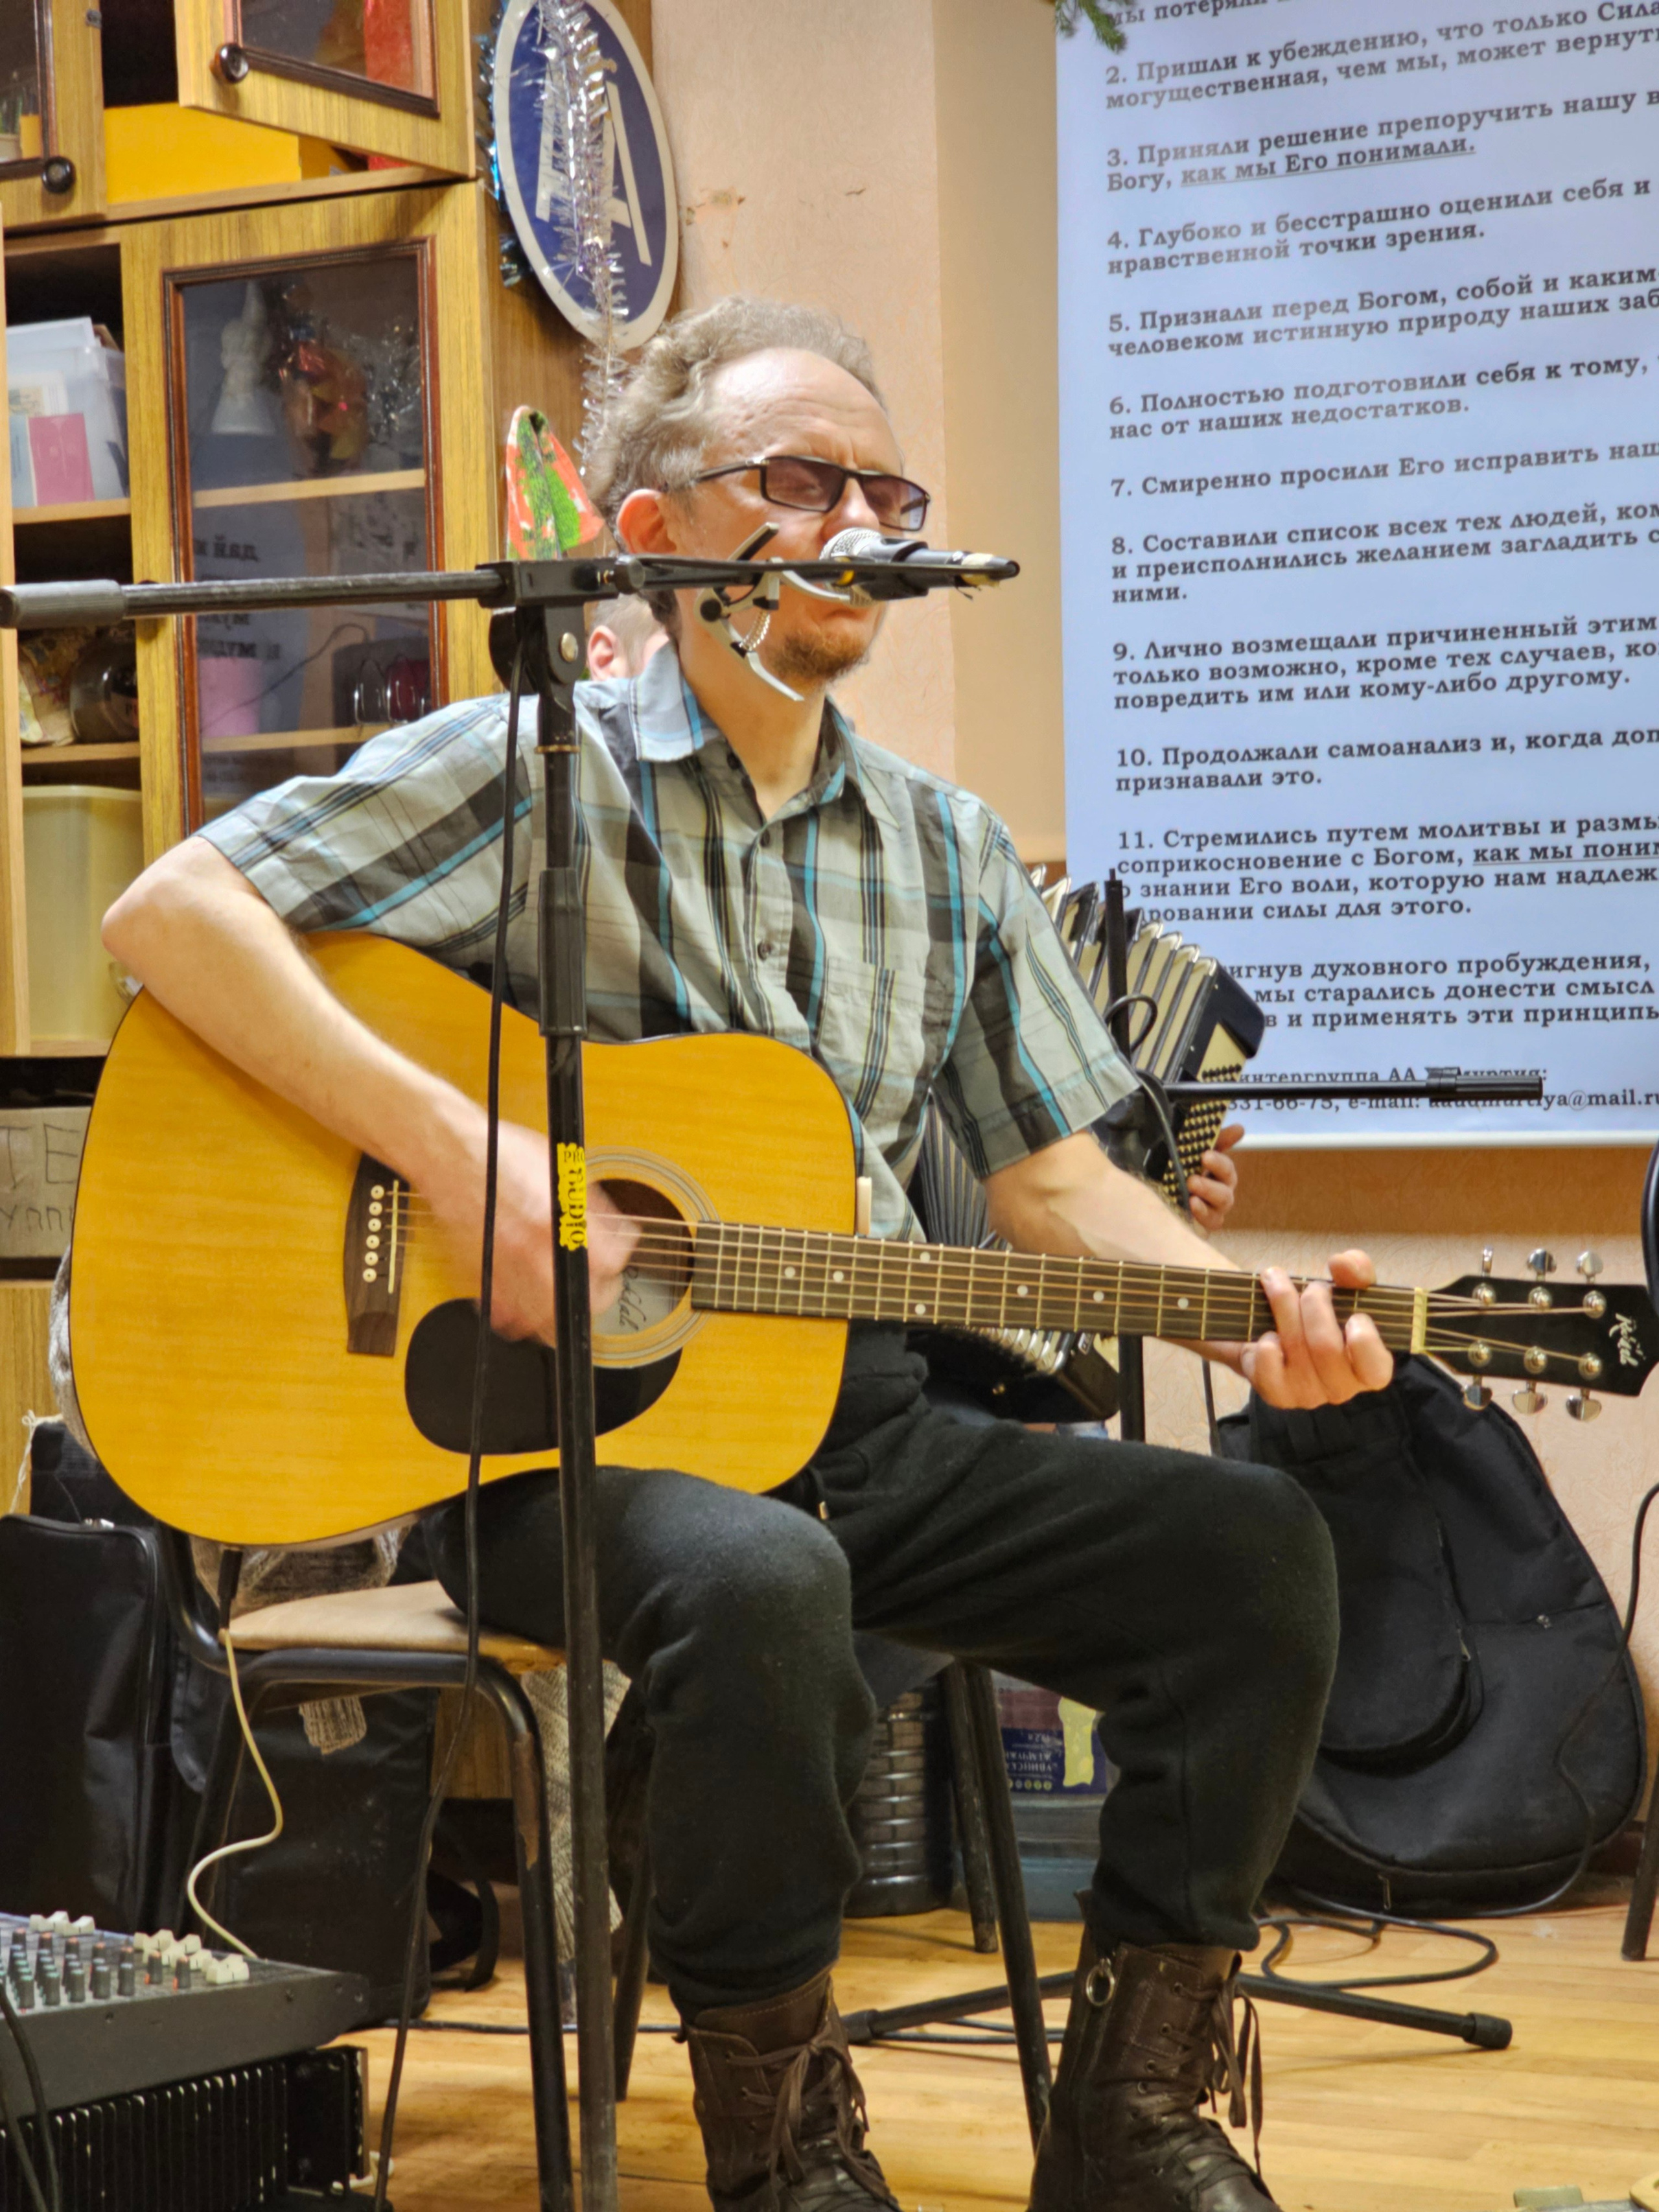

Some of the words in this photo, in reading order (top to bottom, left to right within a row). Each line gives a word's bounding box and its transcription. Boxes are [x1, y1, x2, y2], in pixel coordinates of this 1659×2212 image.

[1106, 65, 1126, 84] 2.
[1137, 55, 1237, 83] Пришли
[1247, 51, 1261, 67] к
[1268, 30, 1427, 69] убеждению,
[1437, 23, 1483, 41] что
[1493, 10, 1587, 34] только
[1107, 69, 1327, 109] могущественная,
[1337, 60, 1386, 80] чем
[1397, 54, 1446, 73] мы,
[1457, 40, 1546, 65] может
[1557, 28, 1659, 55] вернут
[1108, 148, 1127, 167] 3.
[1138, 139, 1249, 167] Приняли
[1259, 124, 1368, 156] решение
[1378, 102, 1553, 139] препоручить
[1563, 92, 1636, 115] нашу
[1108, 172, 1171, 193] Богу,
[1182, 167, 1226, 186] как
[1236, 161, 1275, 178] мы
[1286, 154, 1328, 174] Его
[1338, 138, 1474, 167] понимали.
[1108, 231, 1128, 250] 4.
[1139, 222, 1241, 249] Глубоко
[1251, 222, 1266, 235] и
[1276, 204, 1430, 233] бесстрашно
[1439, 190, 1552, 216] оценили
[1563, 178, 1623, 203] себя
[1634, 180, 1650, 196] и
[1108, 239, 1289, 279] нравственной
[1299, 235, 1376, 256] точки
[1386, 224, 1484, 252] зрения.
[1109, 313, 1130, 332] 5.
[1140, 305, 1262, 333] Признали
[1273, 298, 1349, 320] перед
[1358, 289, 1446, 310] Богом,
[1456, 274, 1533, 301] собой
[1543, 277, 1559, 292] и
[1569, 267, 1659, 290] каким
[1108, 332, 1243, 356] человеком
[1253, 320, 1388, 344] истинную
[1398, 308, 1510, 336] природу
[1520, 298, 1610, 321] наших
[1109, 396, 1130, 415] 6.
[1141, 387, 1284, 413] Полностью
[1294, 373, 1466, 400] подготовили
[1476, 360, 1535, 386] себя
[1545, 364, 1562, 380] к
[1570, 357, 1647, 378] тому,
[1110, 423, 1152, 439] нас
[1161, 419, 1189, 436] от
[1199, 412, 1282, 432] наших
[1292, 399, 1468, 425] недостатков.
[1111, 478, 1131, 497] 7.
[1142, 472, 1271, 497] Смиренно
[1281, 463, 1388, 489] просили
[1398, 457, 1444, 476] Его
[1455, 448, 1599, 474] исправить
[1112, 536, 1132, 555] 8.
[1143, 530, 1277, 553] Составили
[1287, 523, 1379, 544] список
[1389, 519, 1447, 537] всех
[1456, 515, 1502, 532] тех
[1510, 502, 1606, 529] людей,
[1112, 565, 1127, 579] и
[1137, 551, 1347, 581] преисполнились
[1356, 541, 1491, 564] желанием
[1502, 531, 1638, 554] загладить
[1112, 586, 1187, 604] ними.
[1113, 642, 1134, 662] 9.
[1144, 640, 1222, 660] Лично
[1232, 633, 1376, 655] возмещали
[1387, 614, 1577, 650] причиненный
[1588, 616, 1657, 634] этим
[1113, 668, 1200, 686] только
[1209, 660, 1346, 681] возможно,
[1356, 655, 1437, 677] кроме
[1446, 651, 1491, 668] тех
[1500, 645, 1614, 669] случаев,
[1625, 642, 1659, 658] ко
[1114, 690, 1249, 713] повредить
[1259, 688, 1294, 703] им
[1304, 684, 1350, 701] или
[1360, 671, 1497, 701] кому-либо
[1505, 669, 1629, 695] другому.
[1118, 748, 1152, 767] 10.
[1162, 745, 1318, 770] Продолжали
[1328, 737, 1481, 759] самоанализ
[1491, 736, 1515, 754] и,
[1526, 731, 1603, 750] когда
[1116, 773, 1262, 797] признавали
[1272, 770, 1321, 786] это.
[1119, 830, 1153, 850] 11.
[1163, 829, 1317, 852] Стремились
[1327, 826, 1408, 848] путем
[1418, 821, 1540, 839] молитвы
[1550, 819, 1566, 834] и
[1117, 853, 1341, 878] соприкосновение
[1351, 852, 1363, 867] с
[1374, 847, 1463, 867] Богом,
[1473, 847, 1520, 865] как
[1529, 845, 1572, 861] мы
[1141, 882, 1229, 898] знании
[1240, 877, 1282, 895] Его
[1292, 878, 1358, 895] воли,
[1369, 874, 1484, 894] которую
[1494, 871, 1546, 887] нам
[1141, 906, 1253, 923] ровании
[1263, 903, 1327, 920] силы
[1335, 902, 1381, 919] для
[1391, 899, 1471, 916] этого.
[1227, 963, 1303, 983] игнув
[1311, 959, 1447, 982] духовного
[1457, 951, 1649, 978] пробуждения,
[1255, 988, 1295, 1003] мы
[1305, 985, 1435, 1007] старались
[1444, 983, 1555, 1001] донести
[1566, 980, 1654, 996] смысл
[1287, 1014, 1302, 1028] и
[1312, 1010, 1457, 1032] применять
[1467, 1008, 1513, 1024] эти
